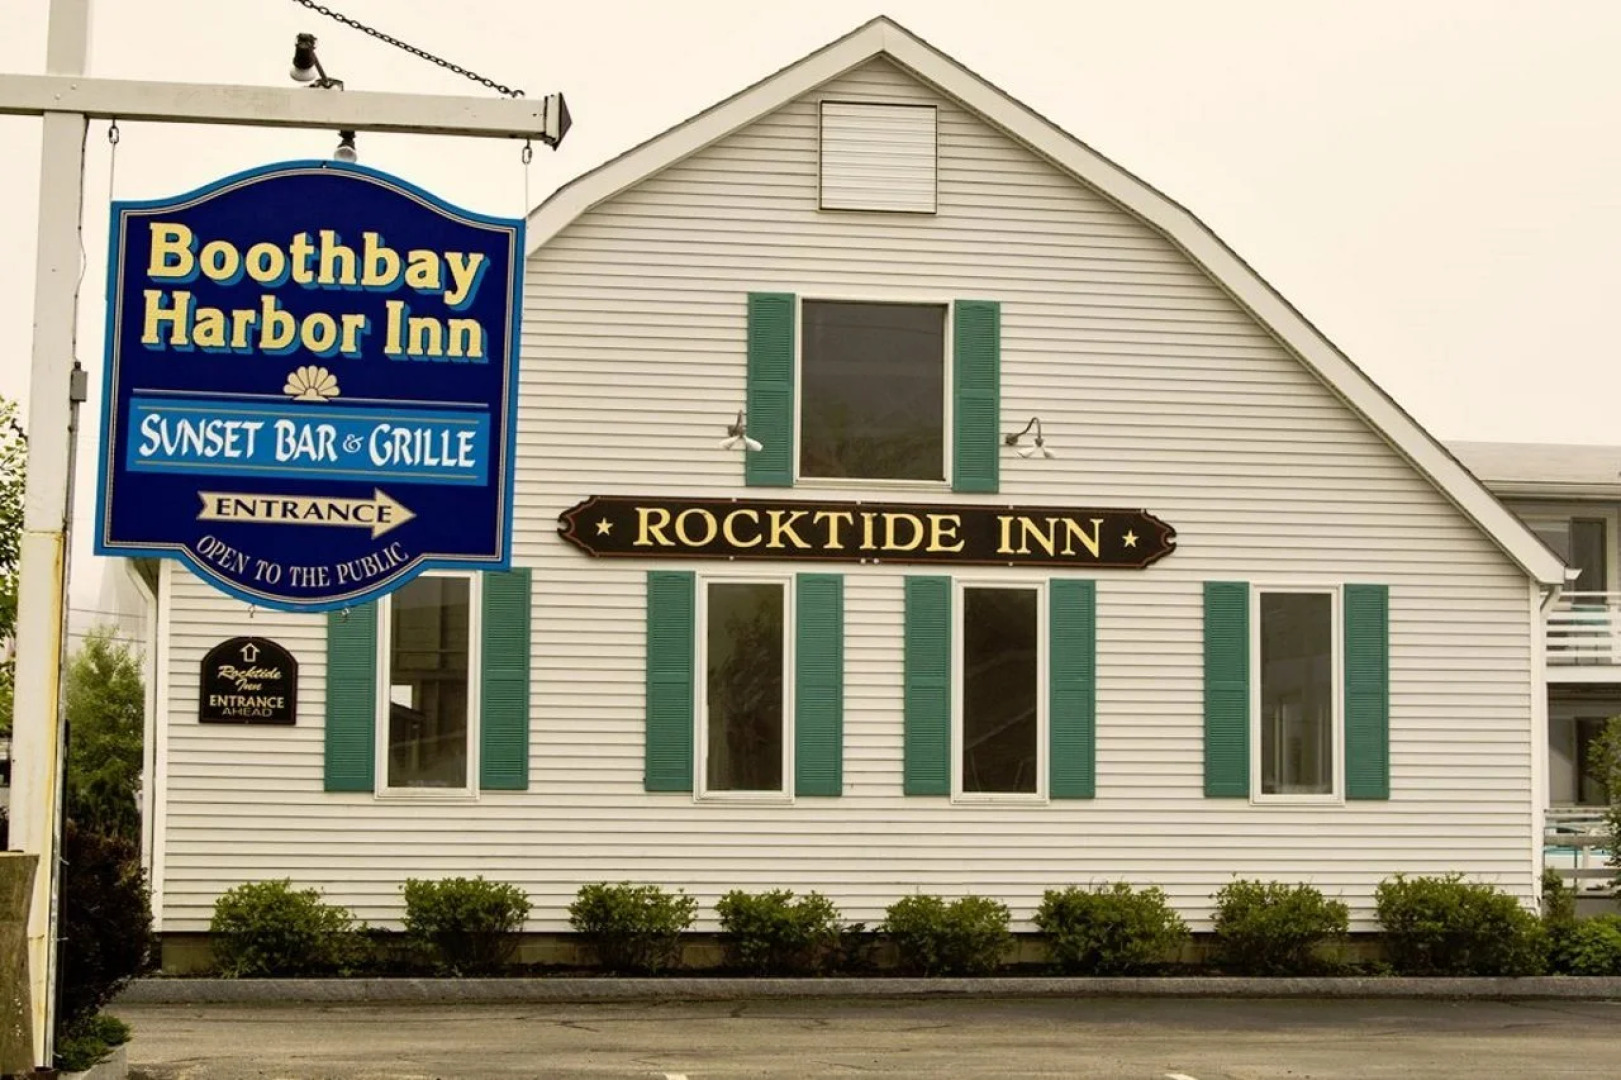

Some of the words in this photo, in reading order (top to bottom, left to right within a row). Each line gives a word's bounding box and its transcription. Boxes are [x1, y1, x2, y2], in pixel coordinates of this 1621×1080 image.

[147, 222, 487, 307] Boothbay
[141, 289, 367, 356] Harbor
[384, 300, 487, 360] Inn
[139, 413, 265, 459] SUNSET
[274, 419, 338, 462] BAR
[343, 433, 365, 453] &
[369, 423, 477, 468] GRILLE
[216, 498, 392, 524] ENTRANCE
[633, 507, 965, 553] ROCKTIDE
[996, 515, 1103, 557] INN
[197, 534, 249, 574] OPEN
[253, 559, 281, 585] TO
[289, 566, 330, 587] THE
[337, 541, 409, 582] PUBLIC
[218, 665, 282, 680] Rocktide
[209, 694, 285, 709] ENTRANCE
[222, 707, 273, 717] AHEAD
